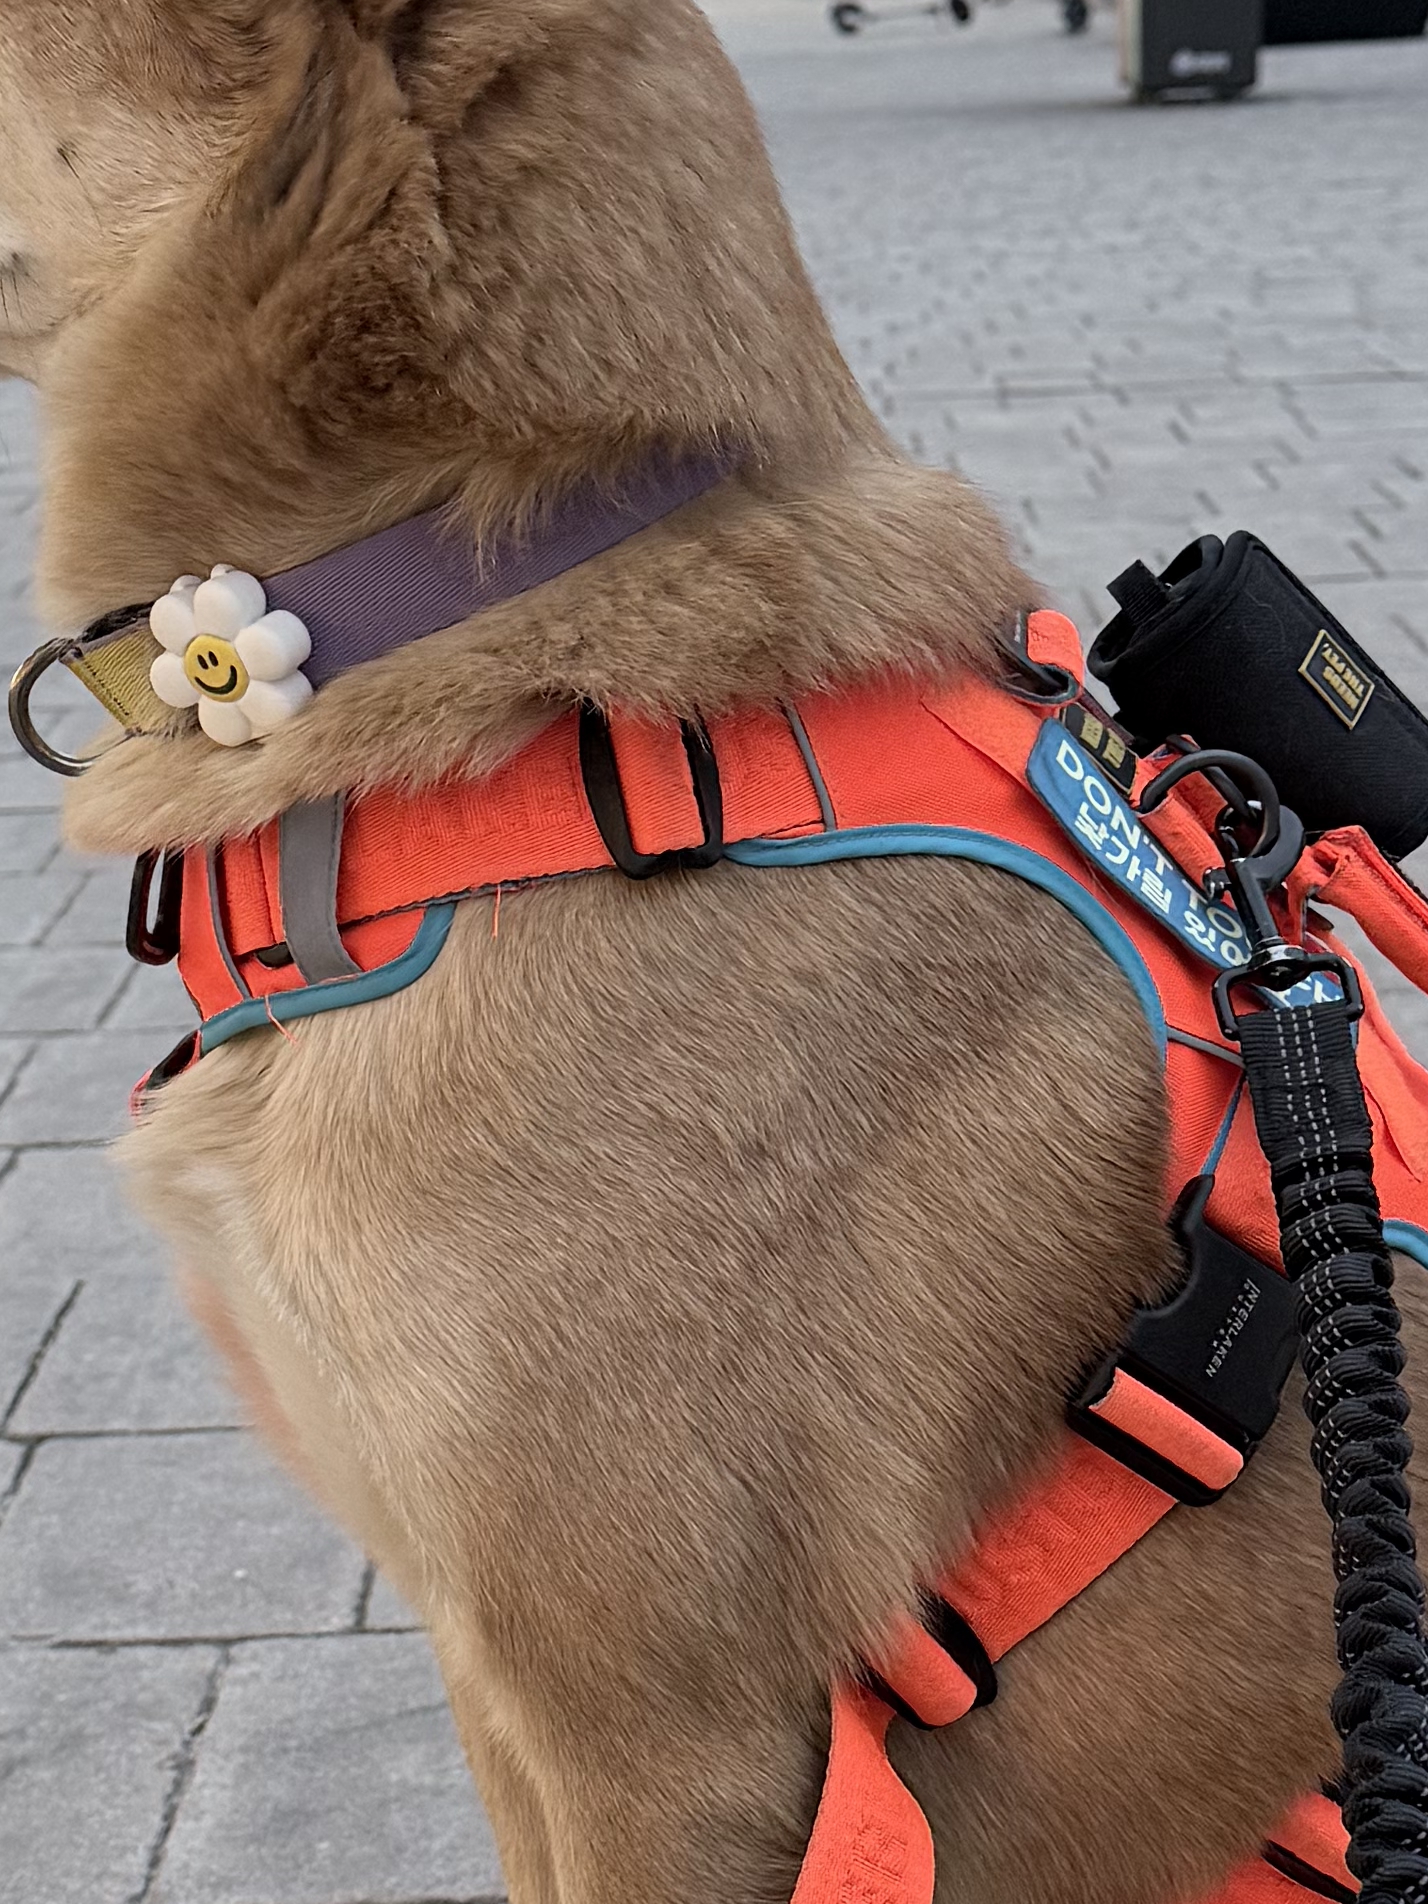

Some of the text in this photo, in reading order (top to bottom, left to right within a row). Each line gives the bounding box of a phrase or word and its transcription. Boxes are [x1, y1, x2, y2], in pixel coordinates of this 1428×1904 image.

[1056, 740, 1173, 875] DON'T
[1074, 802, 1172, 914] 낯가림
[1206, 1278, 1261, 1377] INTERLAKEN
